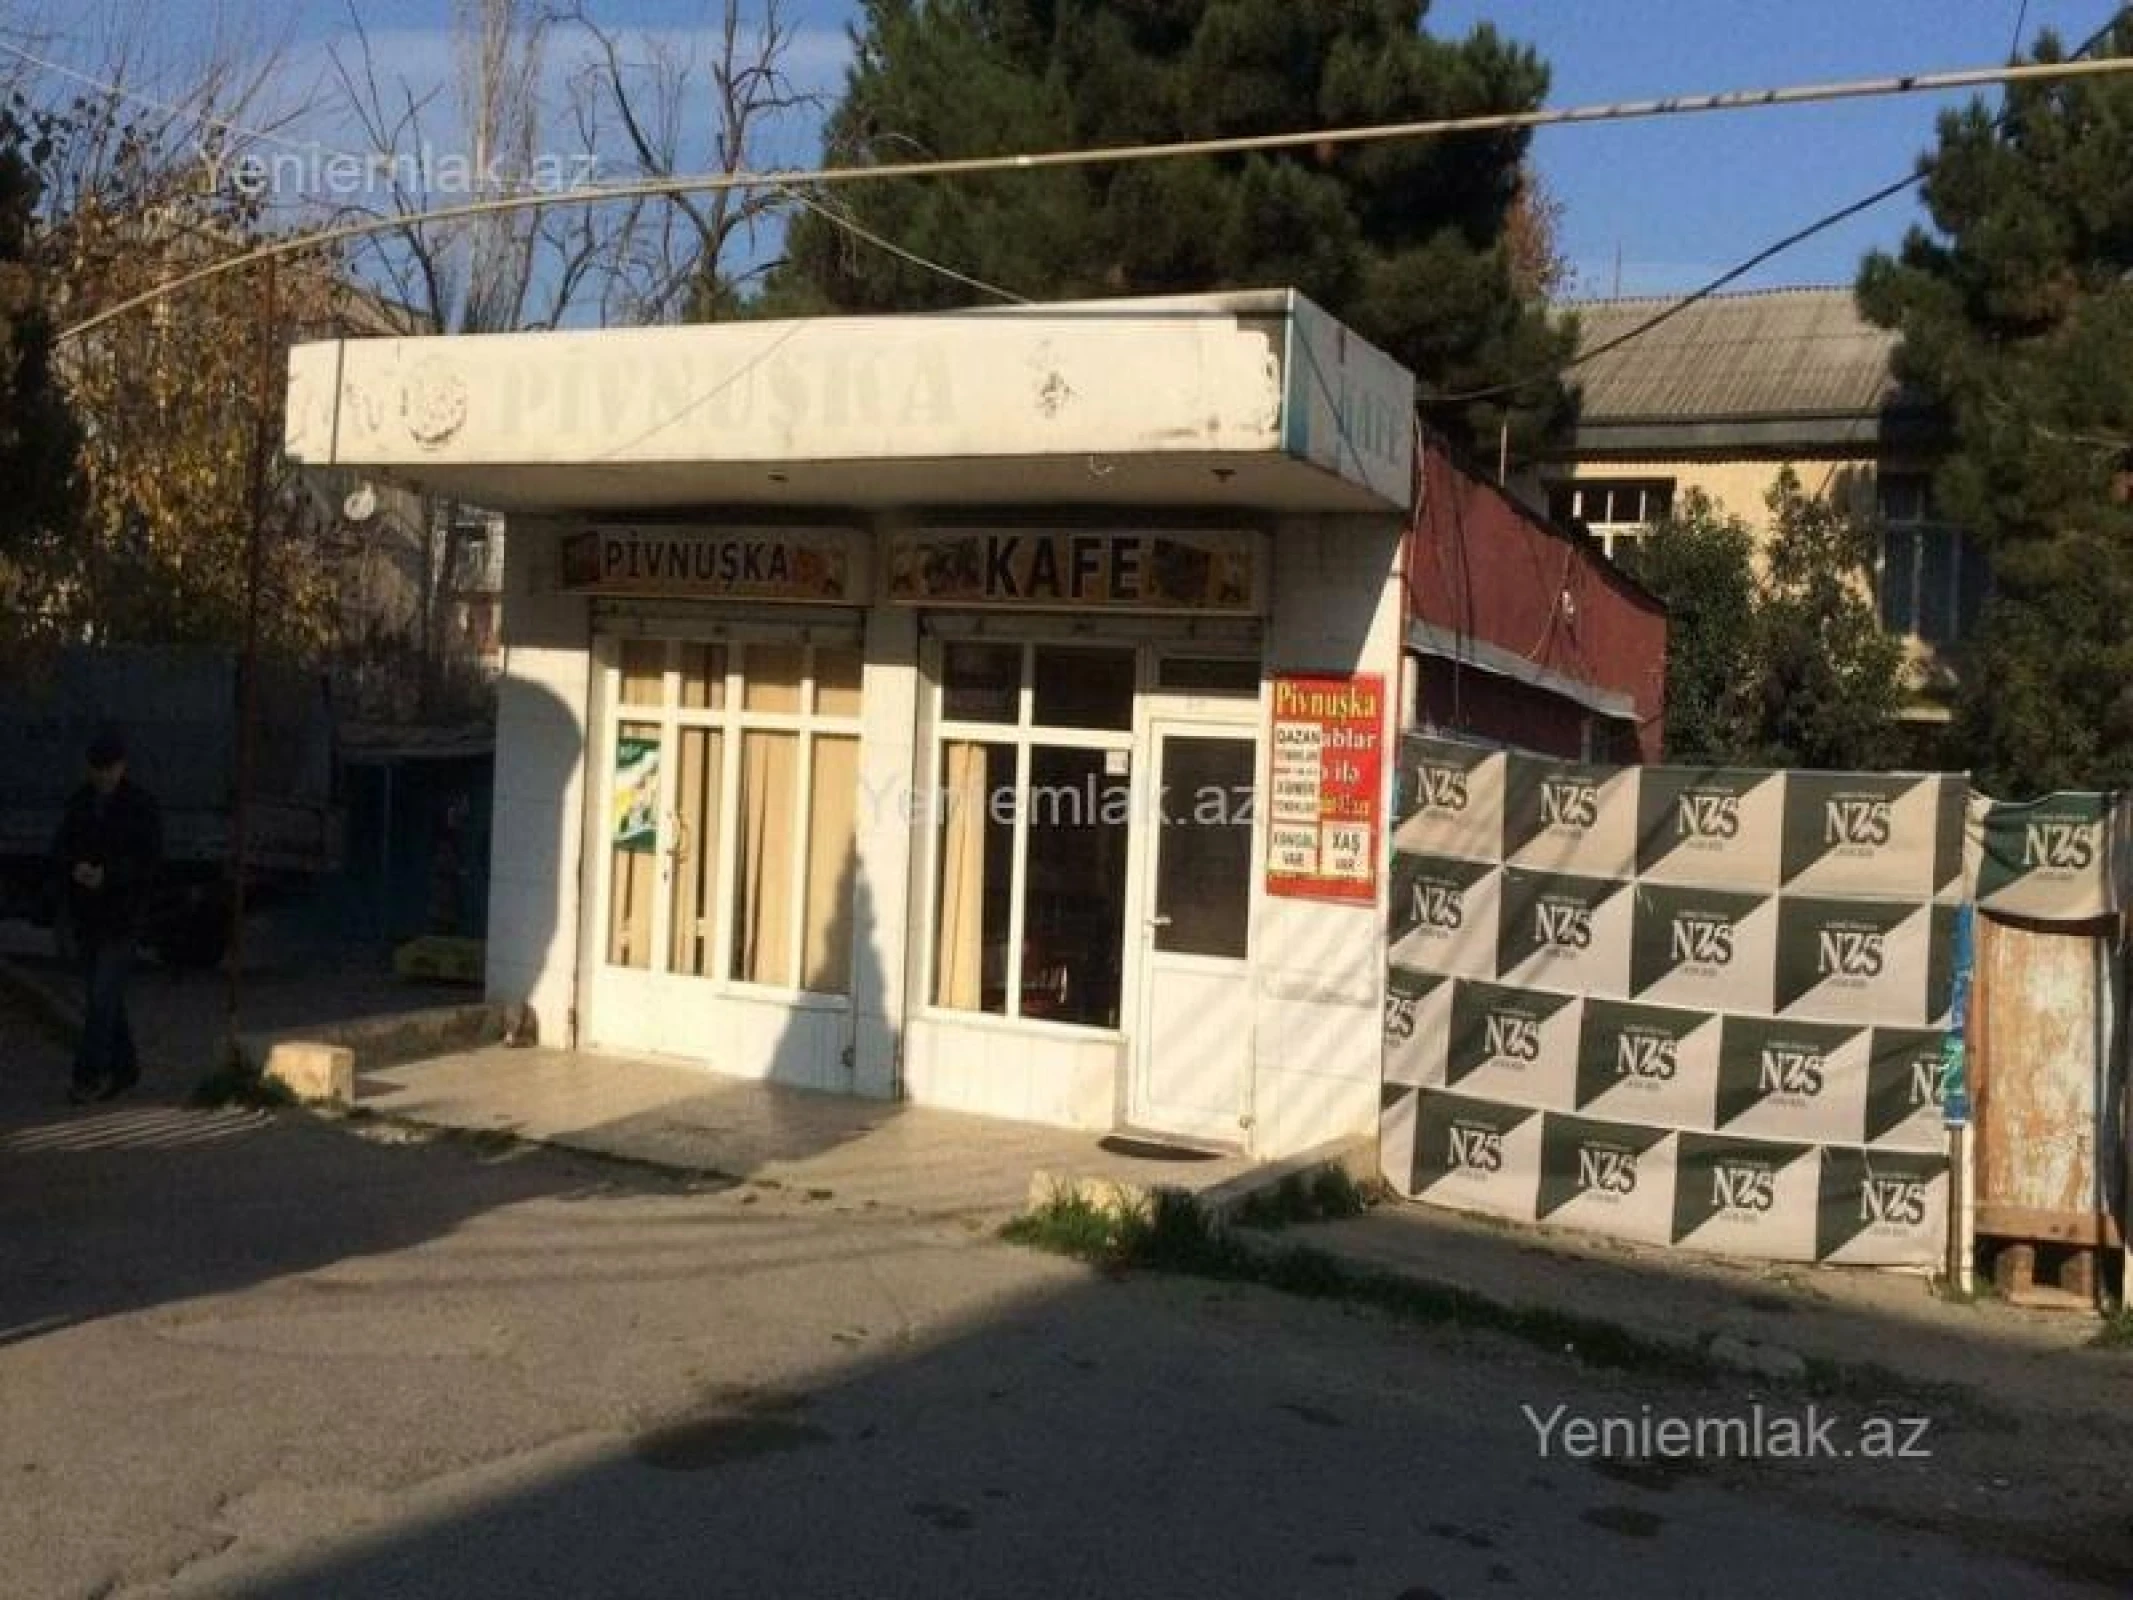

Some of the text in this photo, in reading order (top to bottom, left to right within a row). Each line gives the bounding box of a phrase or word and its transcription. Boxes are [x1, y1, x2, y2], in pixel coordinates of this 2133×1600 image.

[604, 531, 788, 586] PİVNUŞKA
[985, 537, 1142, 599] KAFE
[1277, 682, 1376, 724] Pivnuşka
[1417, 767, 1467, 811] NZS
[1540, 783, 1597, 827] NZS
[1677, 794, 1738, 838] NZS
[1824, 801, 1890, 845] NZS
[2021, 824, 2093, 869] NZS
[1410, 883, 1462, 928] NZS
[1534, 903, 1591, 948] NZS
[1672, 919, 1733, 964] NZS
[1818, 930, 1883, 976] NZS
[1384, 999, 1415, 1037] ZS
[1485, 1015, 1539, 1061] NZS
[1617, 1034, 1676, 1080] NZS
[1760, 1050, 1823, 1096] NZS
[1909, 1061, 1949, 1107] NZ
[1448, 1127, 1501, 1172] NZS
[1578, 1149, 1637, 1194] NZS
[1712, 1167, 1773, 1211] NZS
[1861, 1180, 1924, 1224] NZS
